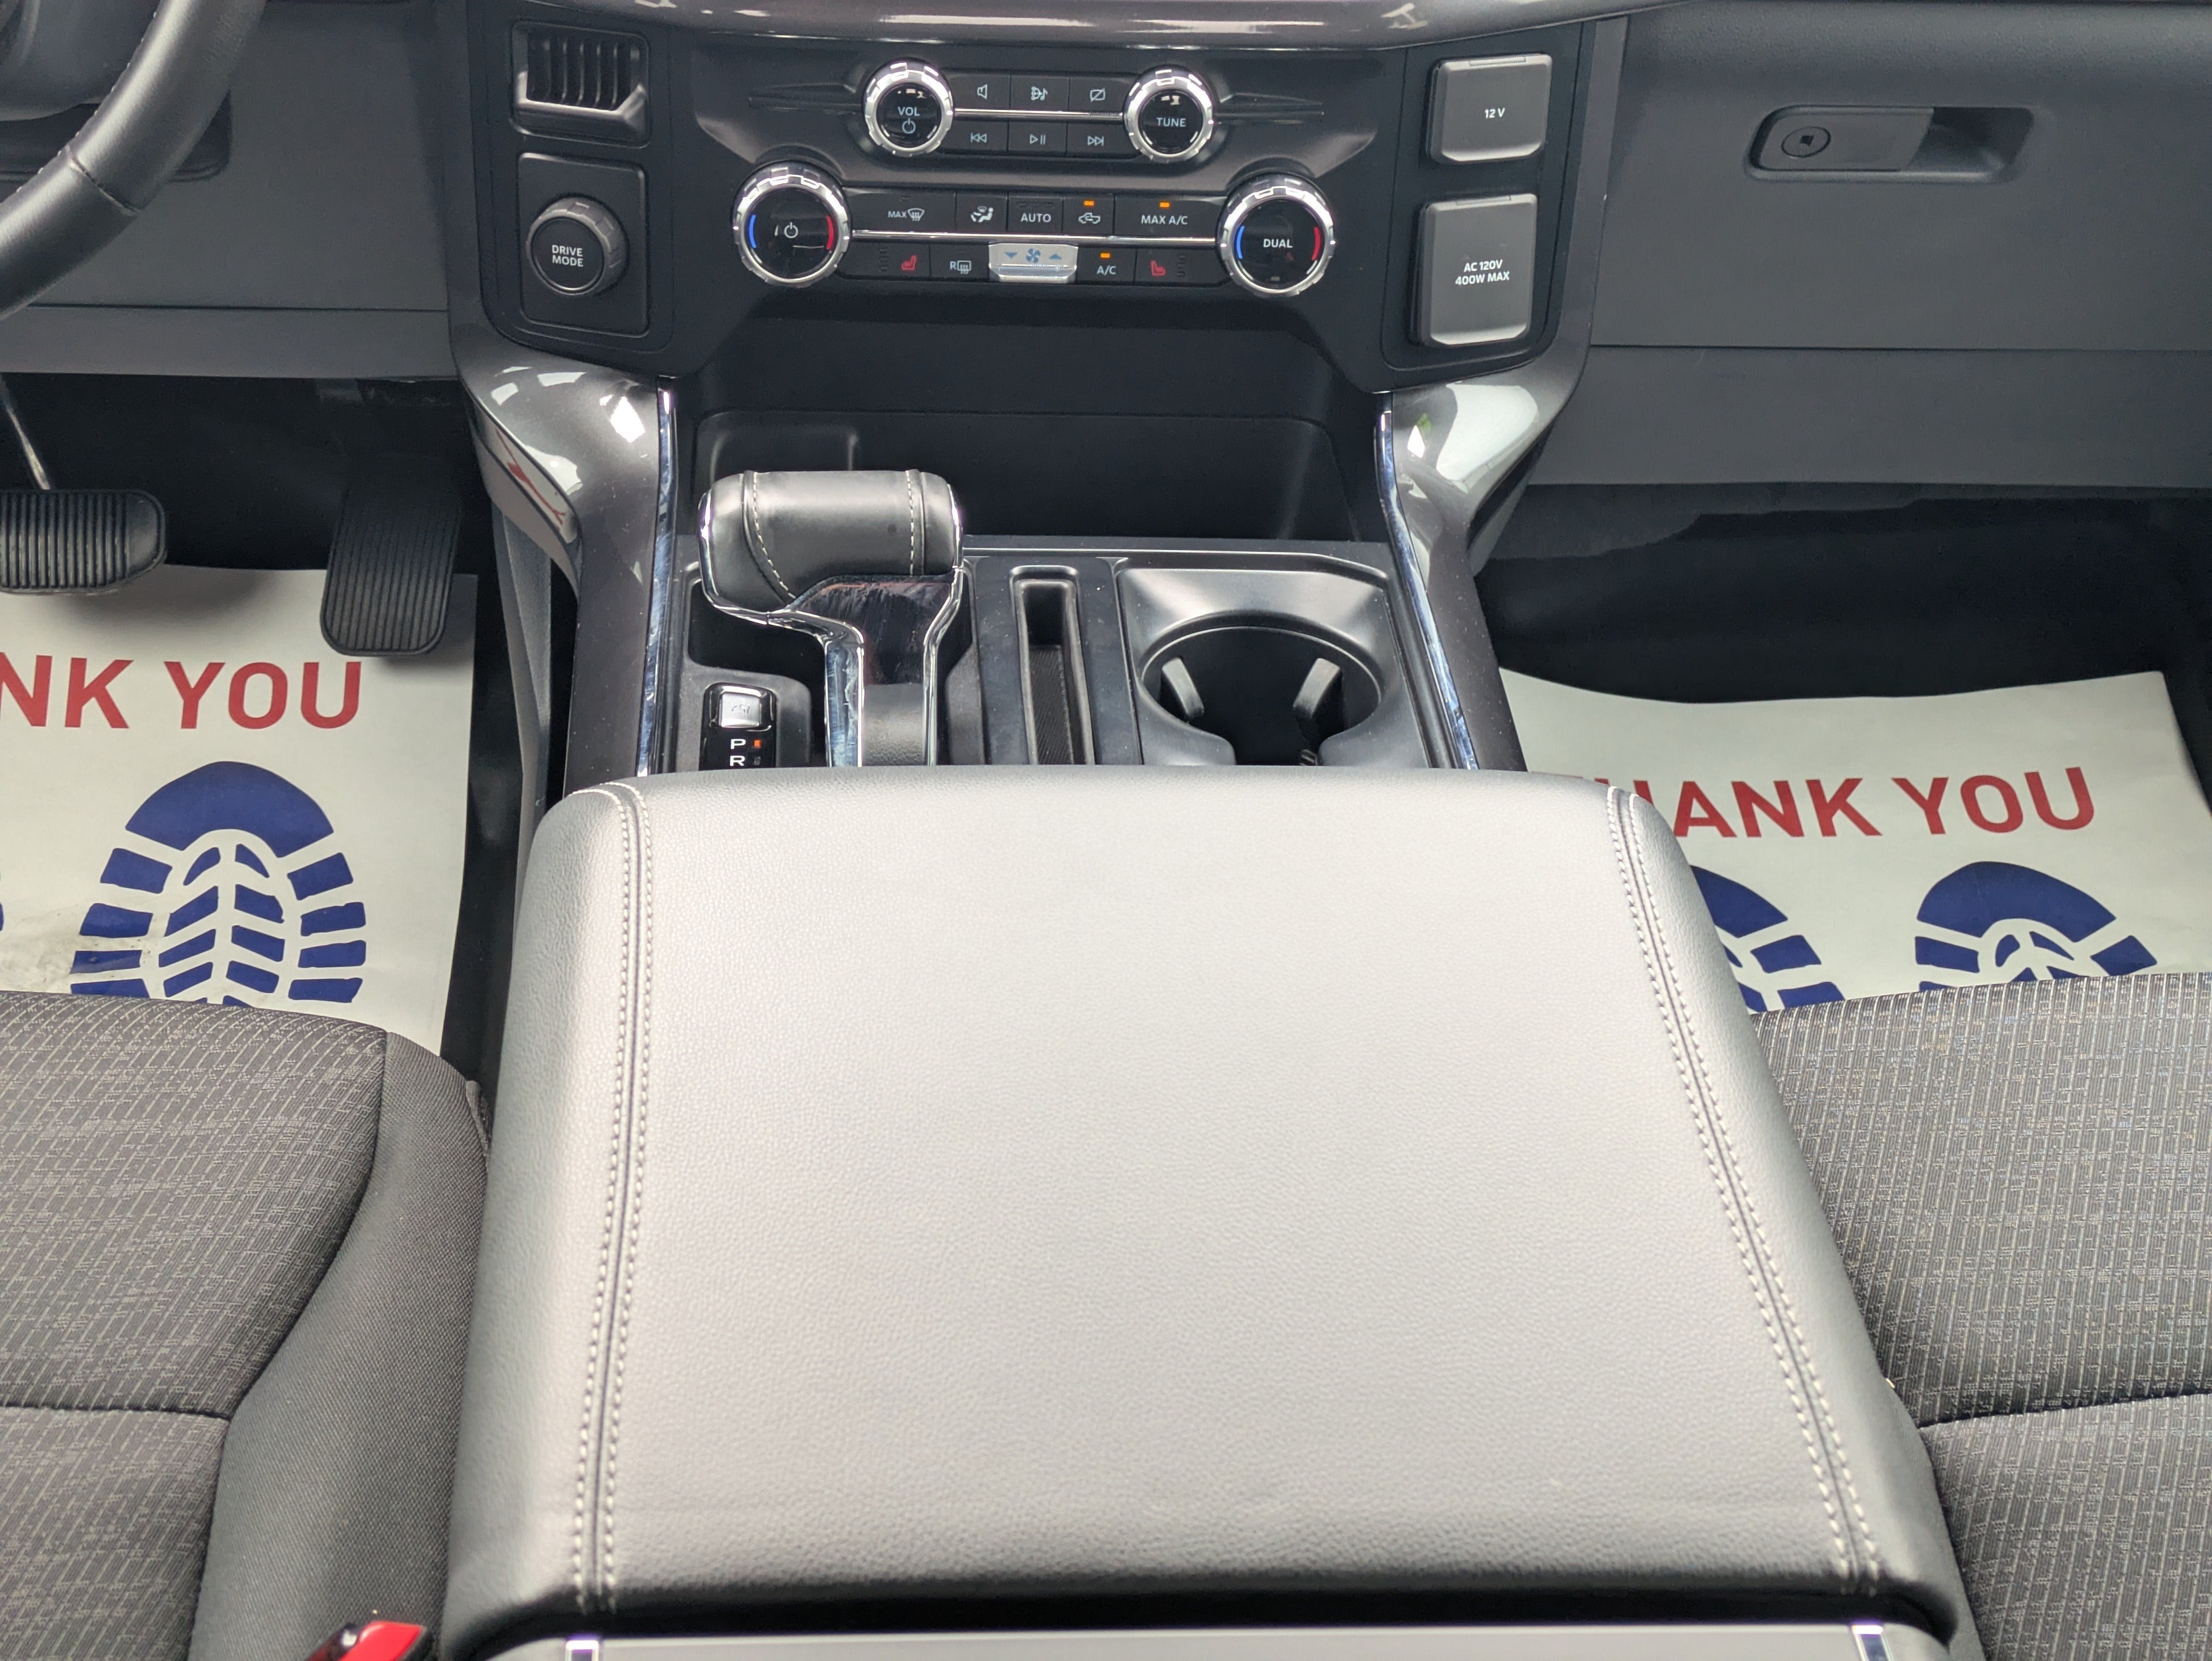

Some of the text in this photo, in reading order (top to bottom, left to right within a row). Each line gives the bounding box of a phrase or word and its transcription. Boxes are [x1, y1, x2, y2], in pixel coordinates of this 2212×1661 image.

[898, 106, 920, 116] VOL
[1484, 108, 1505, 118] 12 V
[1156, 117, 1186, 127] TUNE
[1020, 212, 1051, 222] AUTO
[1141, 215, 1188, 225] MAX A/C
[1263, 239, 1293, 248] DUAL
[552, 244, 583, 256] DRIVE
[552, 255, 584, 267] MODE
[950, 261, 956, 269] R
[1464, 259, 1503, 272] AC 120V
[1096, 265, 1116, 276] A/C
[1455, 271, 1510, 286] 400W MAX
[164, 661, 362, 729] YOU
[730, 739, 746, 750] P
[730, 755, 745, 766] R
[1595, 767, 2095, 837] ANK YOU
